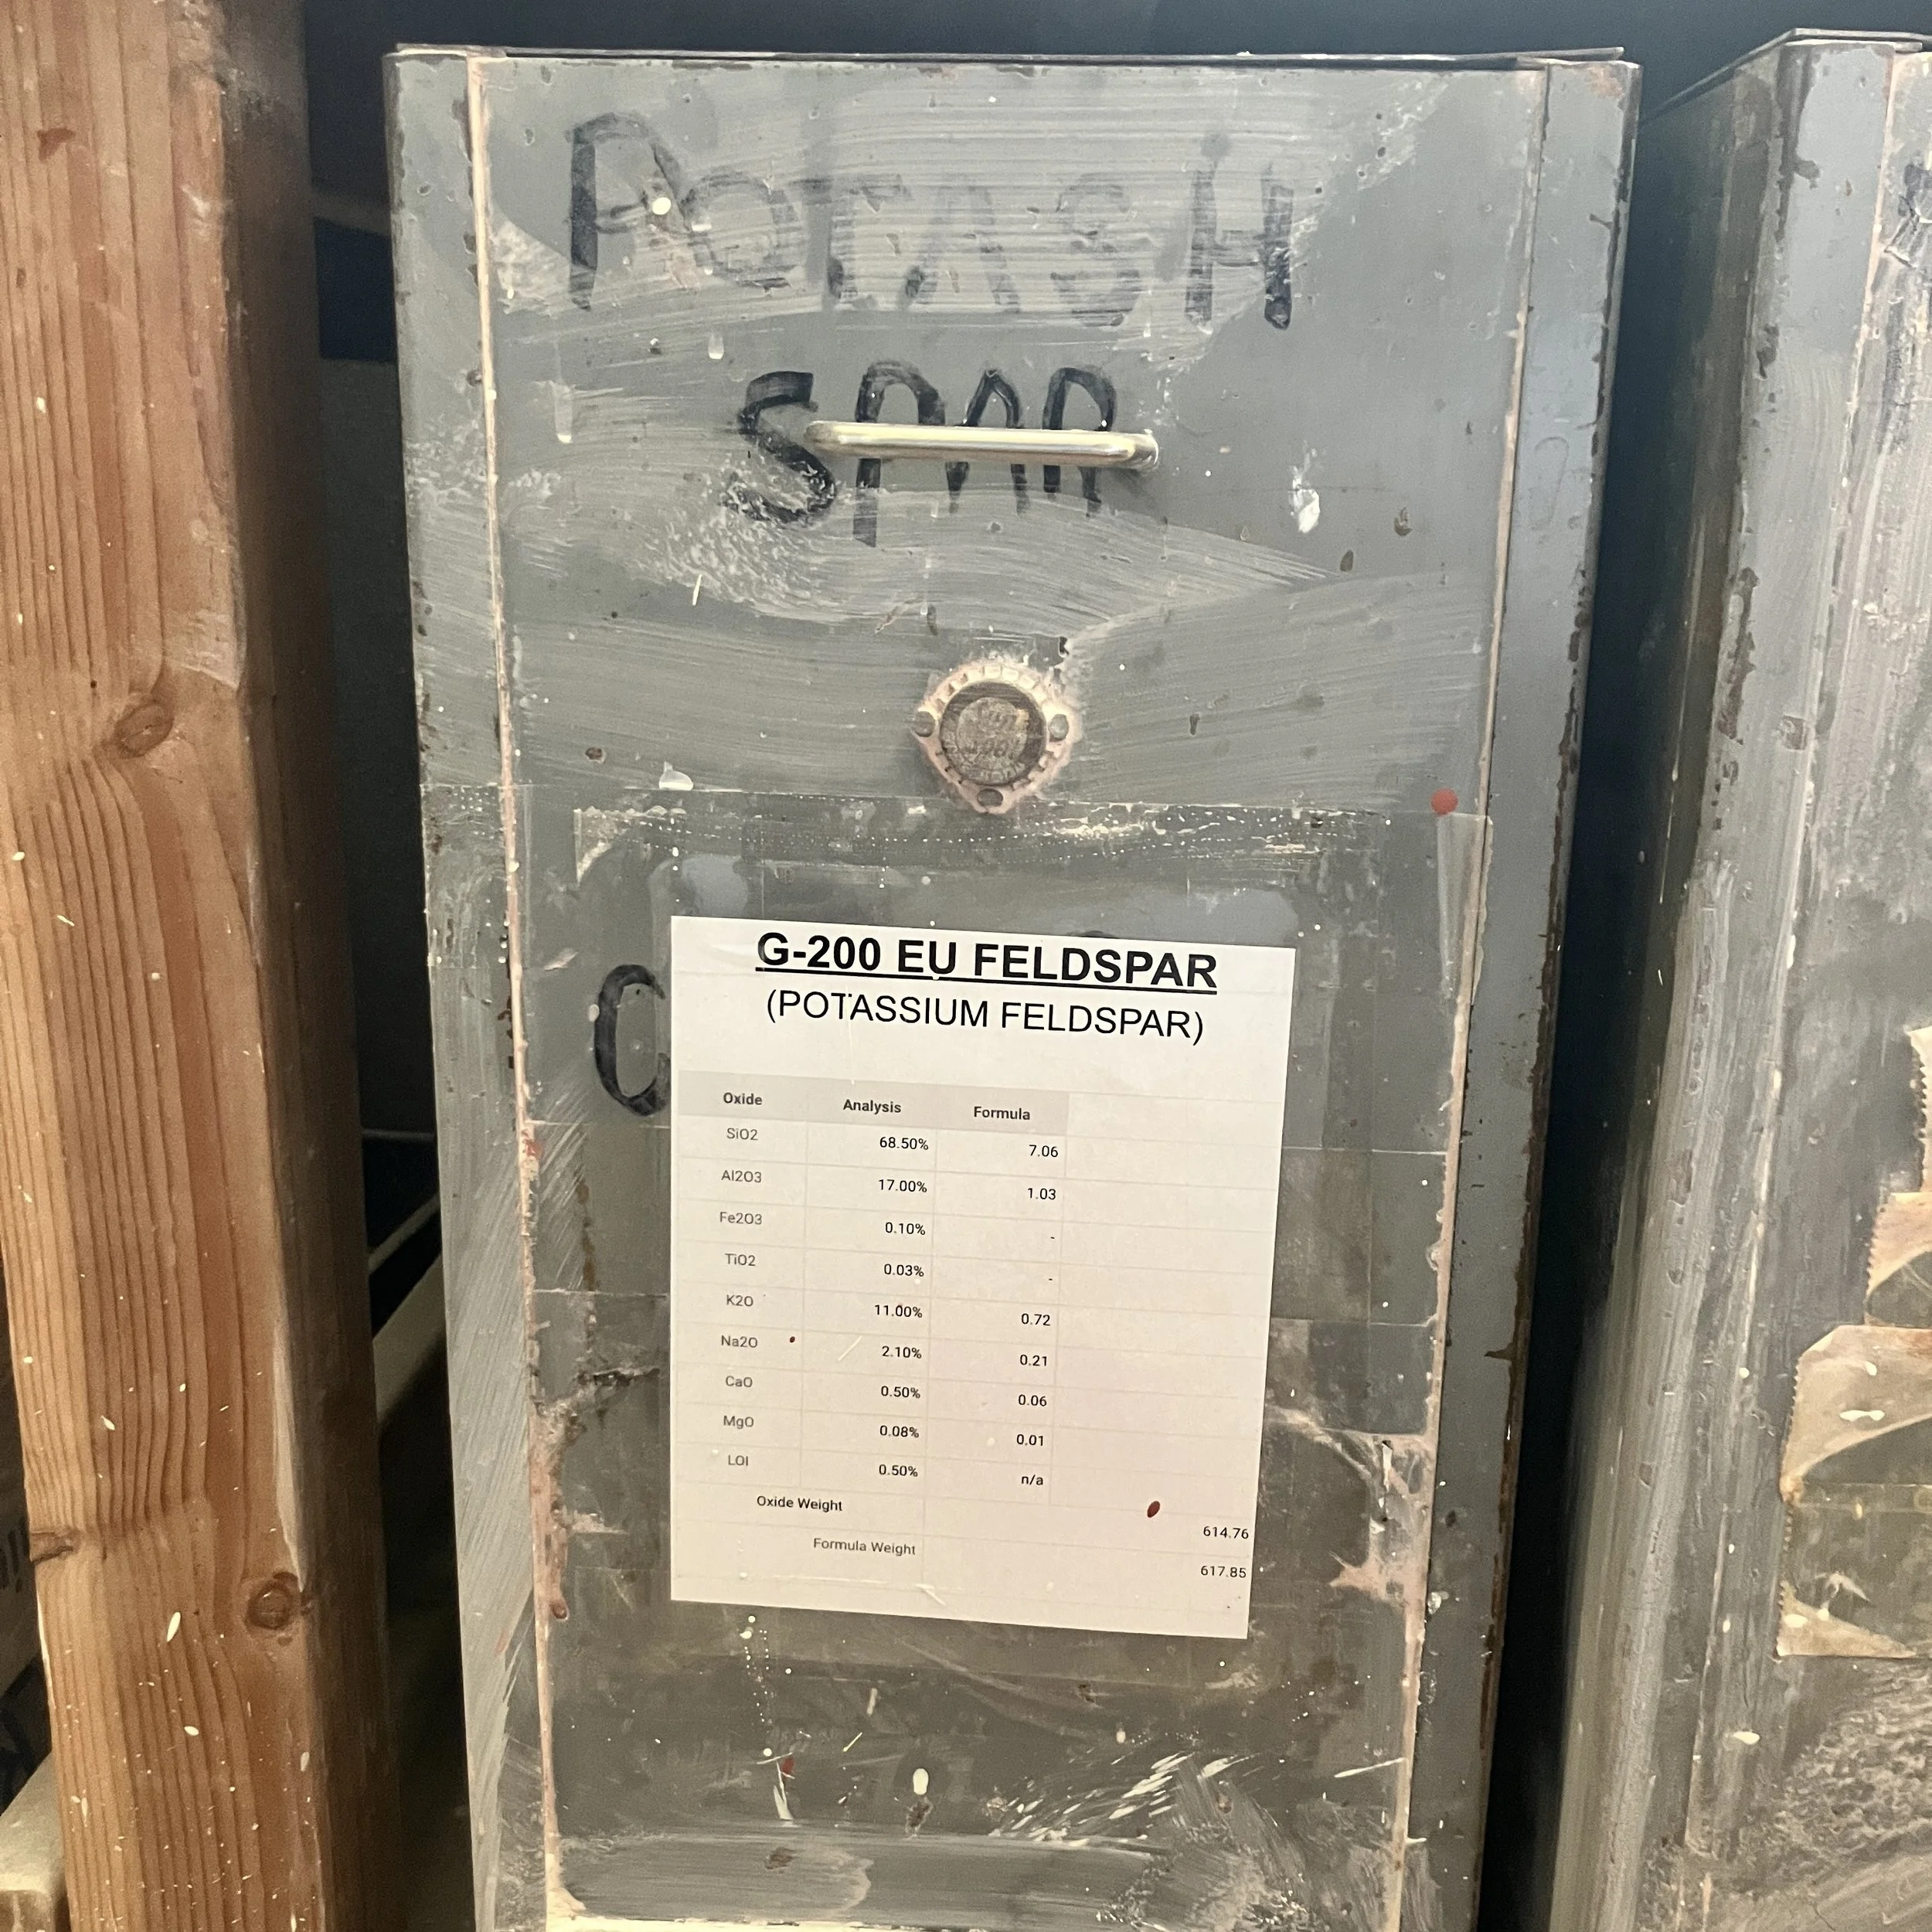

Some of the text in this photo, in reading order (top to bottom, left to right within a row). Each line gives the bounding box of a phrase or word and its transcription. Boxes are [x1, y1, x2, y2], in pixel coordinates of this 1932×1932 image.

[757, 932, 1219, 989] G-200 EU FELDSPAR
[766, 988, 1206, 1046] (POTASSIUM FELDSPAR)
[723, 1092, 1031, 1121] Oxide Analysis Formula
[726, 1127, 1059, 1158] SiO2 68.50% 7.06
[720, 1169, 1056, 1201] Al2O3 17.00% 1.03
[719, 1211, 763, 1226] Fe2O3
[885, 1221, 926, 1236] 0.10%
[724, 1253, 757, 1267] TiO2
[883, 1263, 924, 1277] 0.03%
[726, 1294, 1051, 1326] K2O 11.00% 0.72
[721, 1335, 1047, 1367] Na2O 2.10% 0.21
[725, 1375, 1047, 1407] CaO 0.50% 0.06
[723, 1415, 1043, 1447] MgO 0.08% 0.01
[727, 1454, 1044, 1486] LOI 0.50% n/a
[757, 1495, 1249, 1539] Oxide Weight 614.76
[813, 1537, 1247, 1579] Formula Weight 617.85
